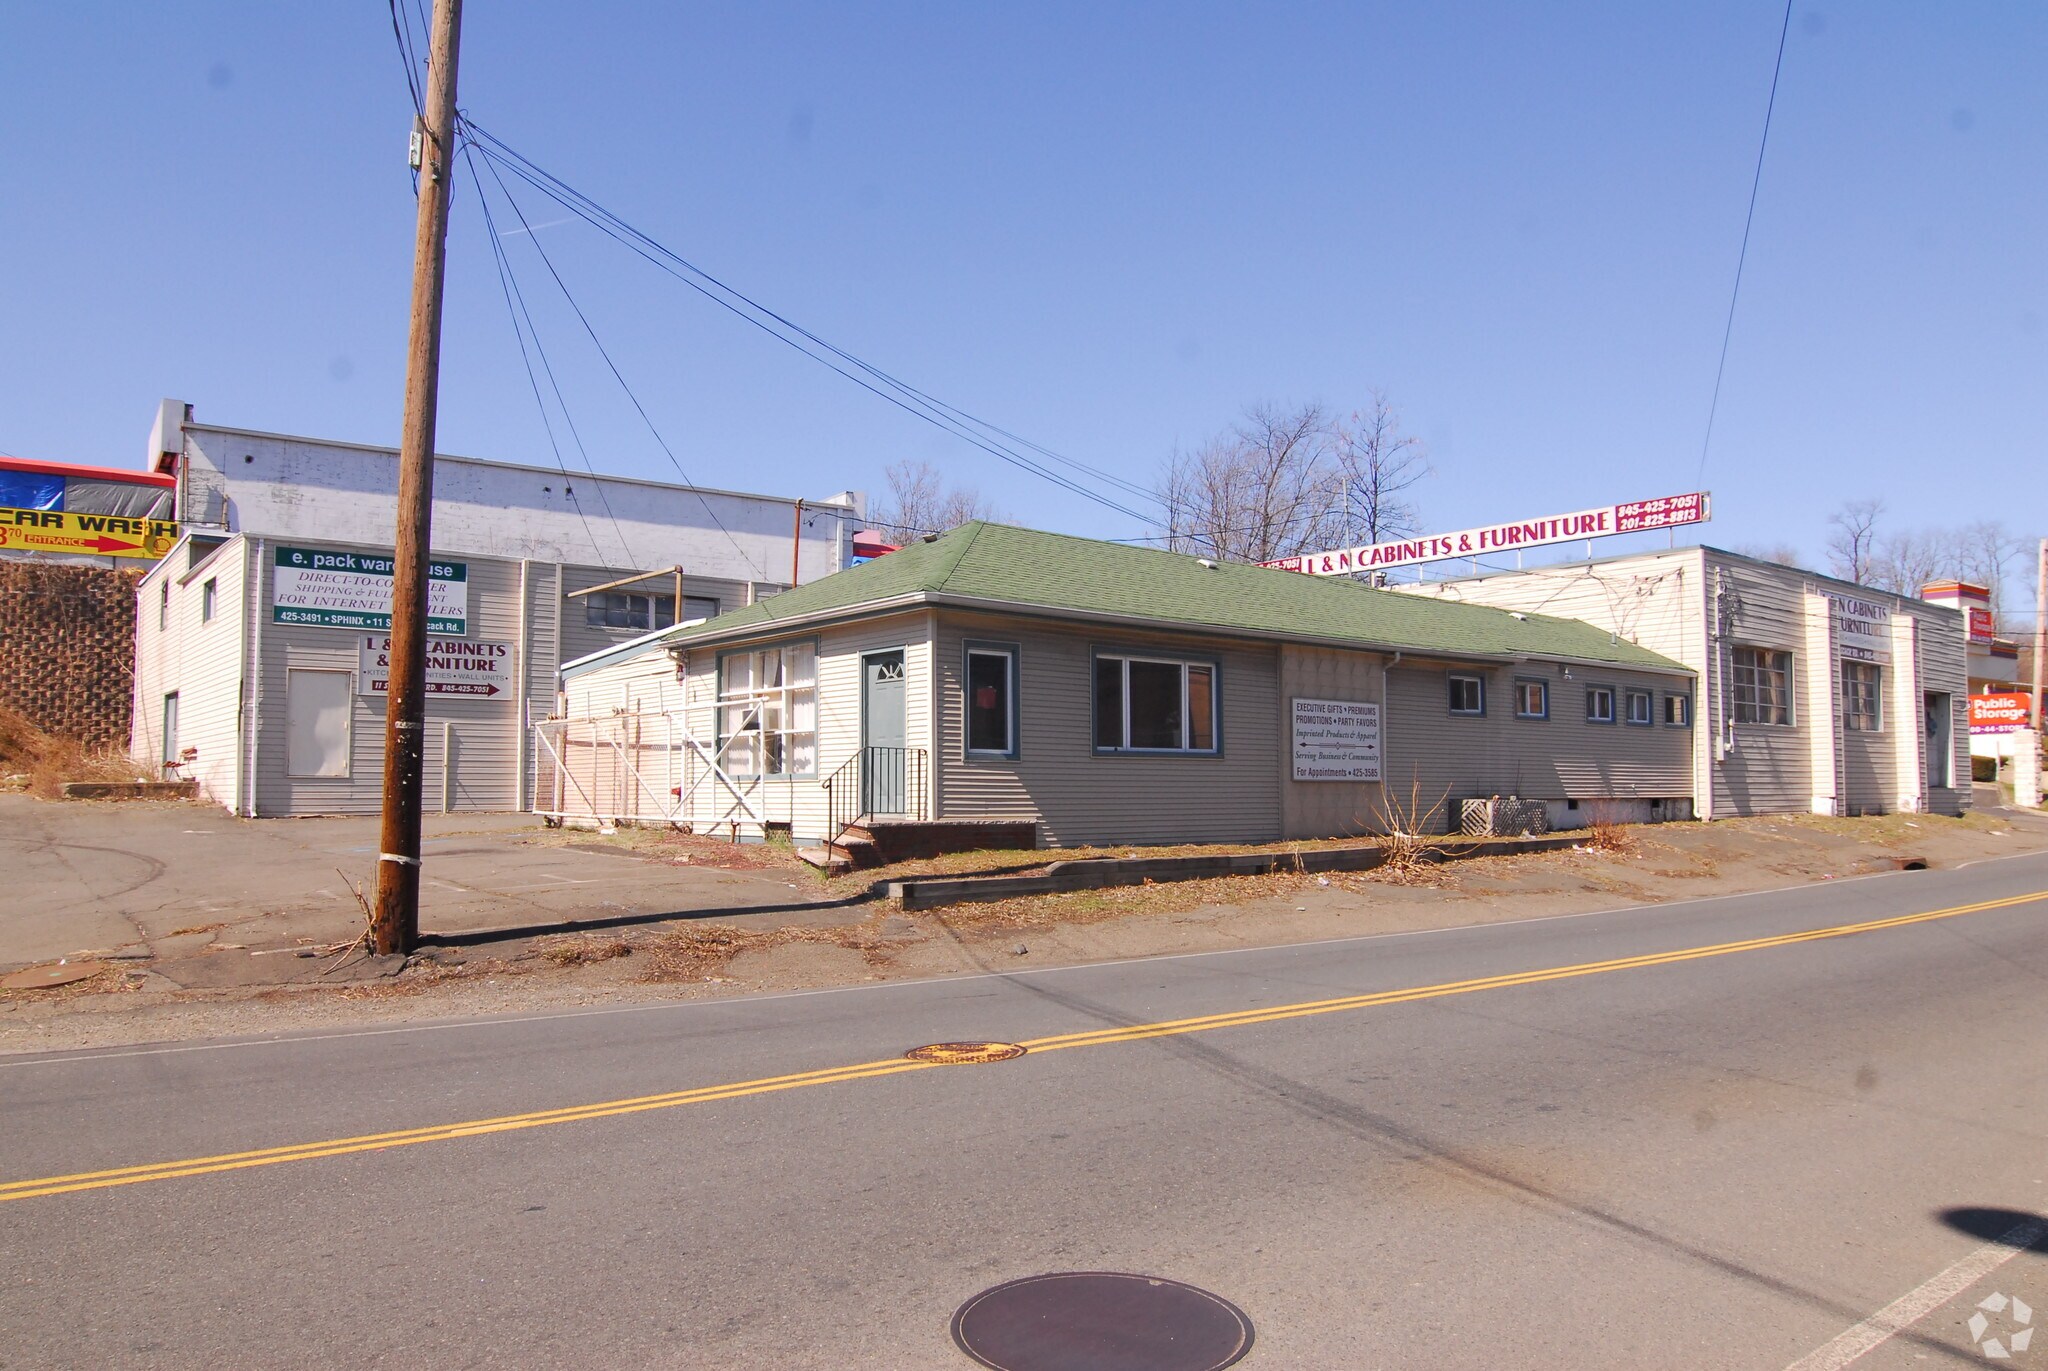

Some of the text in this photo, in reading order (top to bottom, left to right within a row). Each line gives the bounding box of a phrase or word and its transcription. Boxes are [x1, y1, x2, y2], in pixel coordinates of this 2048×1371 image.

[1618, 494, 1698, 518] 845-425-7051
[1620, 508, 1697, 530] 201-825-8813
[77, 516, 178, 538] WASH
[27, 534, 85, 547] ENTRANCE
[1308, 511, 1609, 574] L & N CABINETS & FURNITURE
[292, 552, 453, 577] e. pack warse
[298, 571, 447, 593] DIRECT-TO-COER
[295, 583, 352, 596] SHIPPING
[355, 587, 365, 597] &
[278, 593, 307, 605] FOR
[313, 596, 387, 611] INTERNET
[1847, 599, 1888, 620] CABINETS
[280, 610, 322, 624] 425-3491
[331, 615, 364, 626] SPHINX
[373, 618, 383, 627] 11
[446, 622, 460, 632] Rd.
[366, 637, 377, 650] L
[381, 638, 392, 651] &
[376, 653, 498, 672] & RNITURE
[458, 673, 480, 681] WALL
[482, 674, 504, 682] UNITS
[441, 684, 490, 693] 845-425-7051
[1296, 702, 1376, 716] EXECUTIVE GIFTS PREMIUMS
[1973, 697, 2017, 709] Public
[1295, 714, 1377, 727] PROMOTIONS PARTY FAVORS
[1973, 708, 2027, 720] Storage
[1295, 729, 1324, 739] Imprinted
[1325, 729, 1350, 739] Products
[1356, 731, 1377, 741] Apparel
[1295, 750, 1316, 761] Serving
[1318, 751, 1342, 760] Business
[1348, 752, 1379, 763] Community
[1296, 767, 1307, 776] For
[1308, 767, 1347, 778] Appointments
